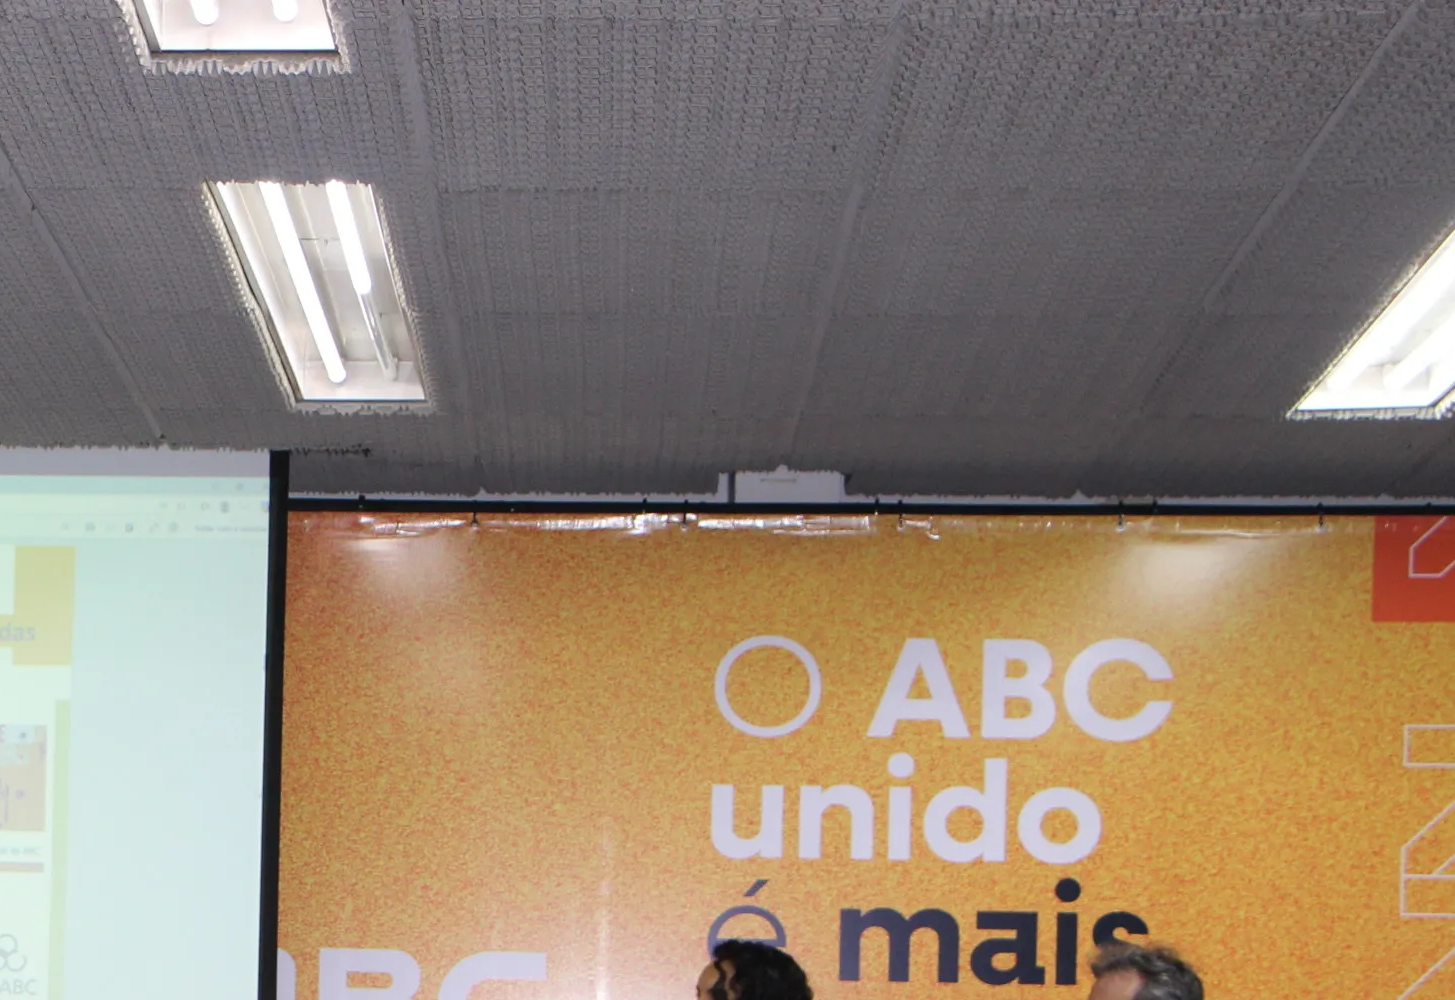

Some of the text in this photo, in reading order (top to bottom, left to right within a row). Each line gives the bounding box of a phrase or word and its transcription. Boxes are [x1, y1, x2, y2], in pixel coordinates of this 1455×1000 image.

[714, 635, 1175, 741] O ABC
[710, 753, 1103, 865] unido
